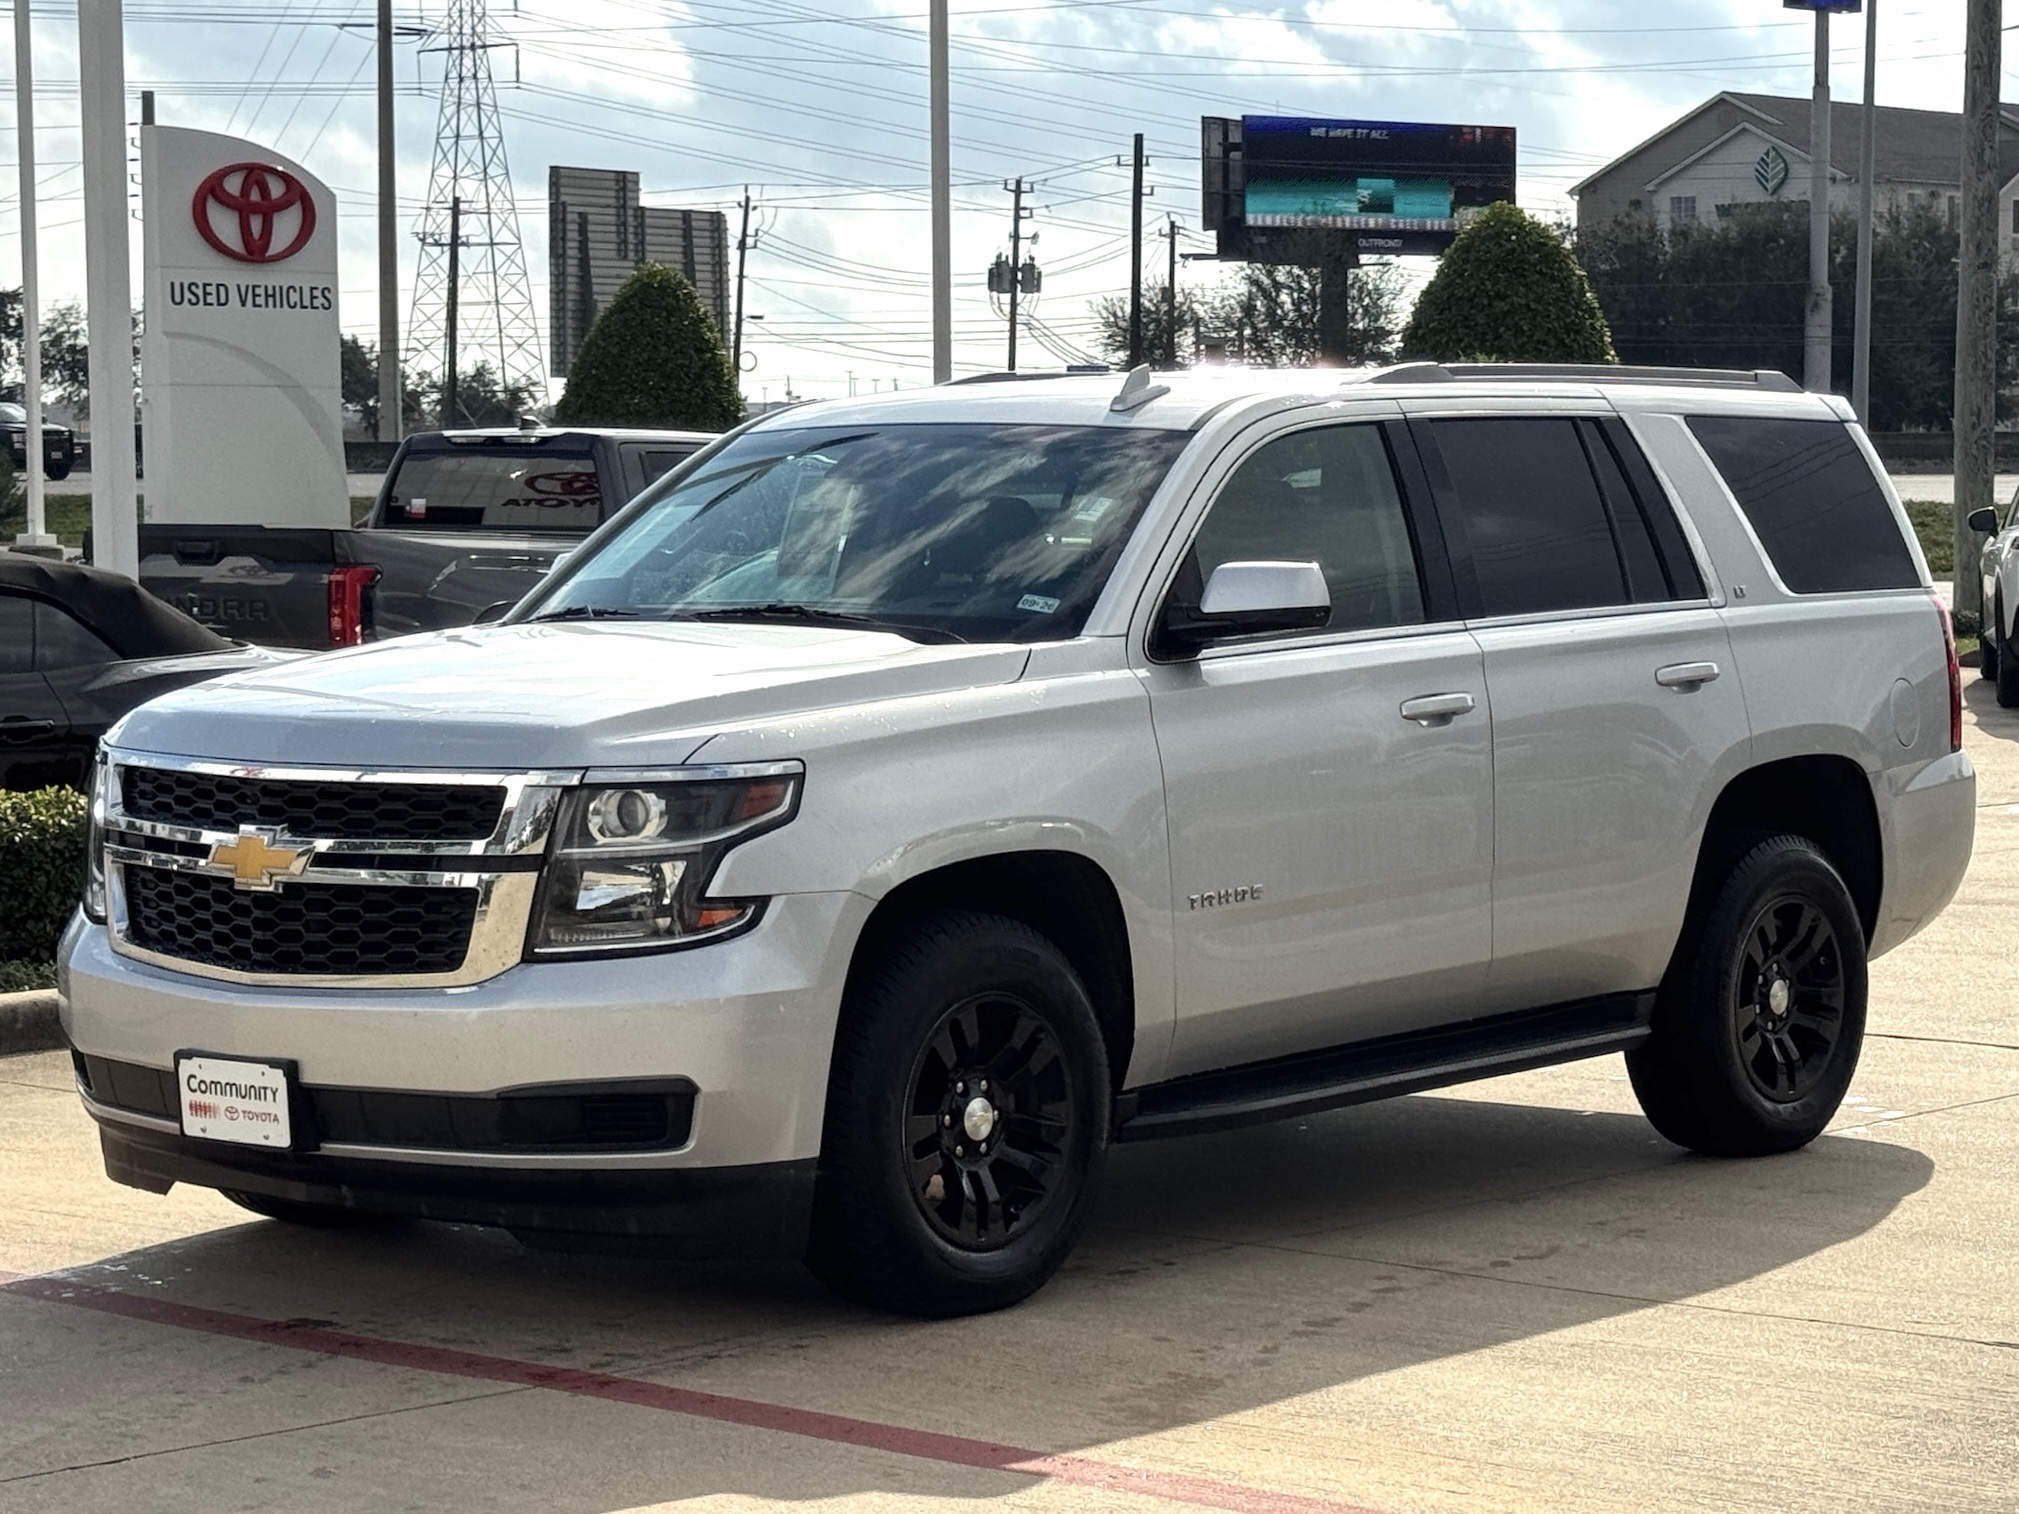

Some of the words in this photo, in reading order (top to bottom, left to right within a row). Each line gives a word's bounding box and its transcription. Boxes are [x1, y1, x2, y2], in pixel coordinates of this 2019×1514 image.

[169, 280, 230, 307] USED
[235, 283, 333, 311] VEHICLES
[1187, 883, 1264, 911] TAHOE
[241, 1109, 280, 1124] TOYOTA
